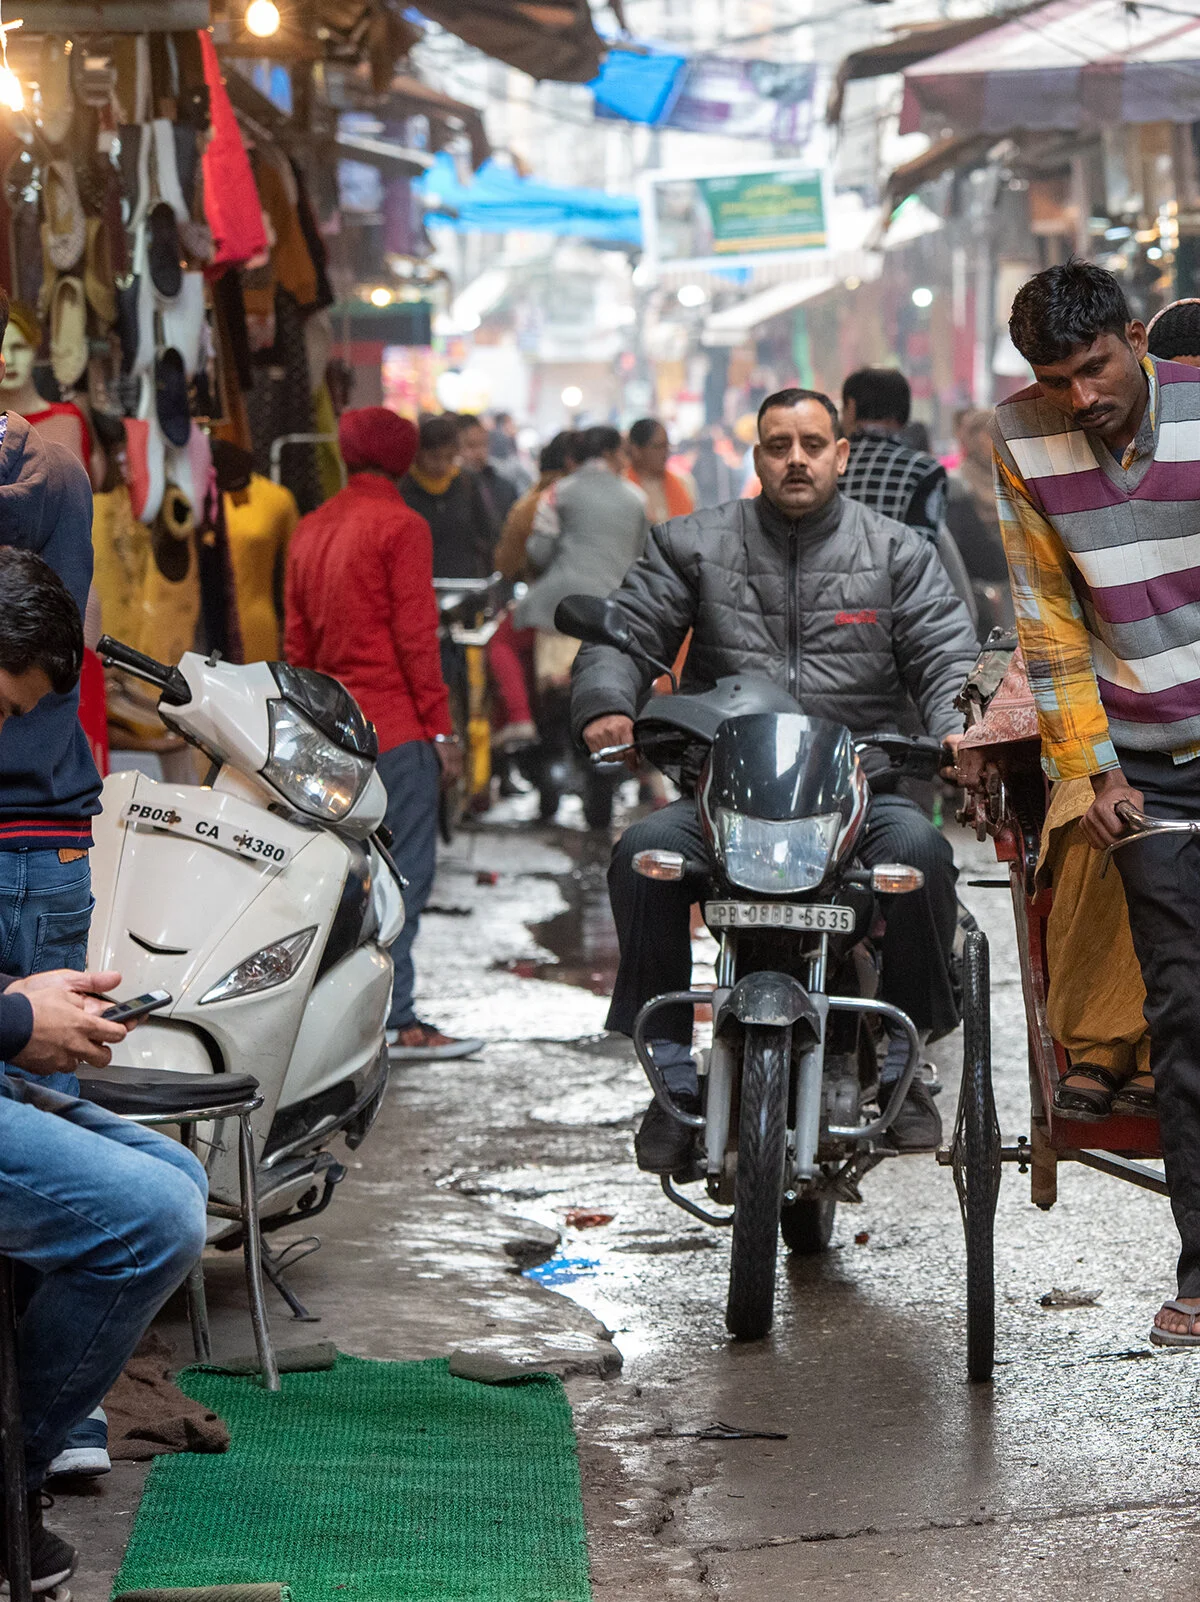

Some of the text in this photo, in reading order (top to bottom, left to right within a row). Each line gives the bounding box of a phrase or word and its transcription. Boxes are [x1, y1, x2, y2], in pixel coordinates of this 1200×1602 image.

[195, 821, 220, 840] CA
[243, 836, 285, 862] 4380
[718, 906, 737, 924] PB
